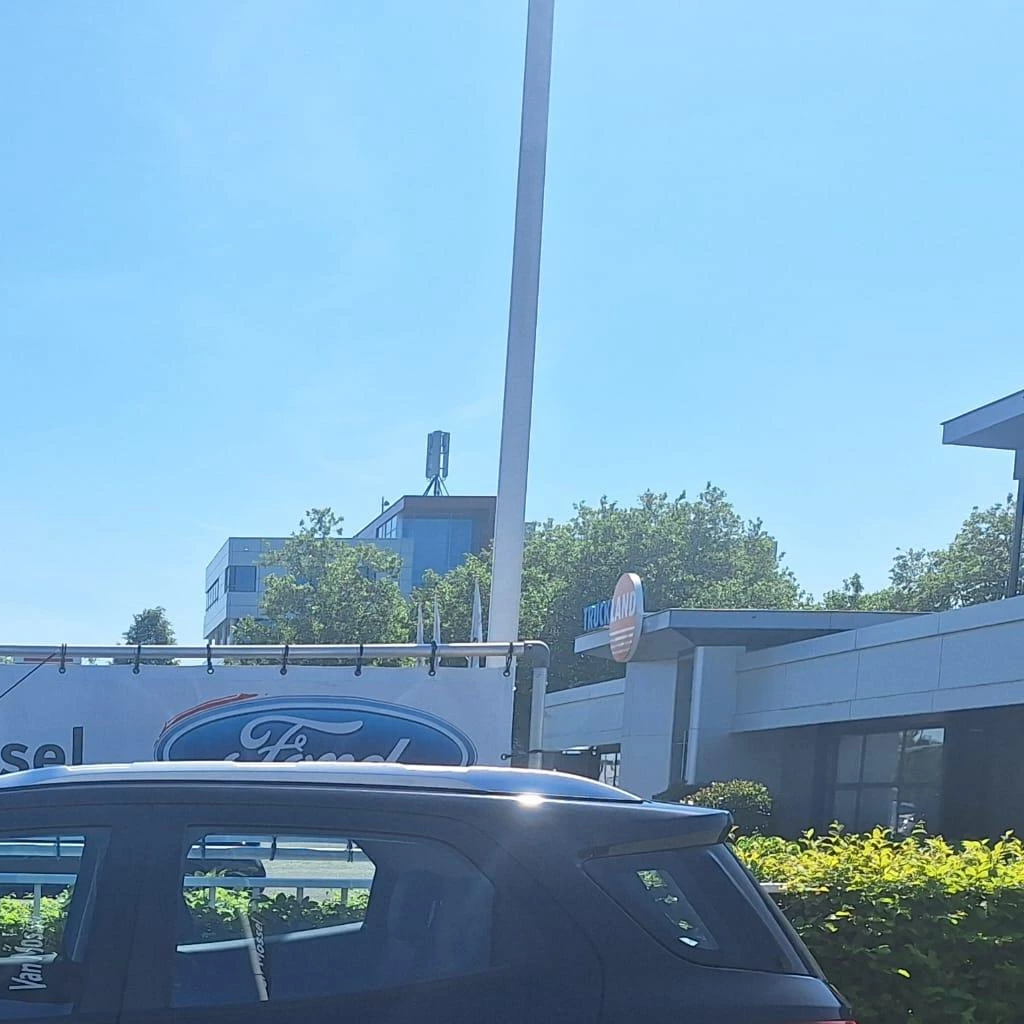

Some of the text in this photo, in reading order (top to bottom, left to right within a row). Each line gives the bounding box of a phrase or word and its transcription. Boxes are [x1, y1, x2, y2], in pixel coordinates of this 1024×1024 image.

[225, 715, 411, 763] Fd
[8, 916, 47, 990] Van Mos
